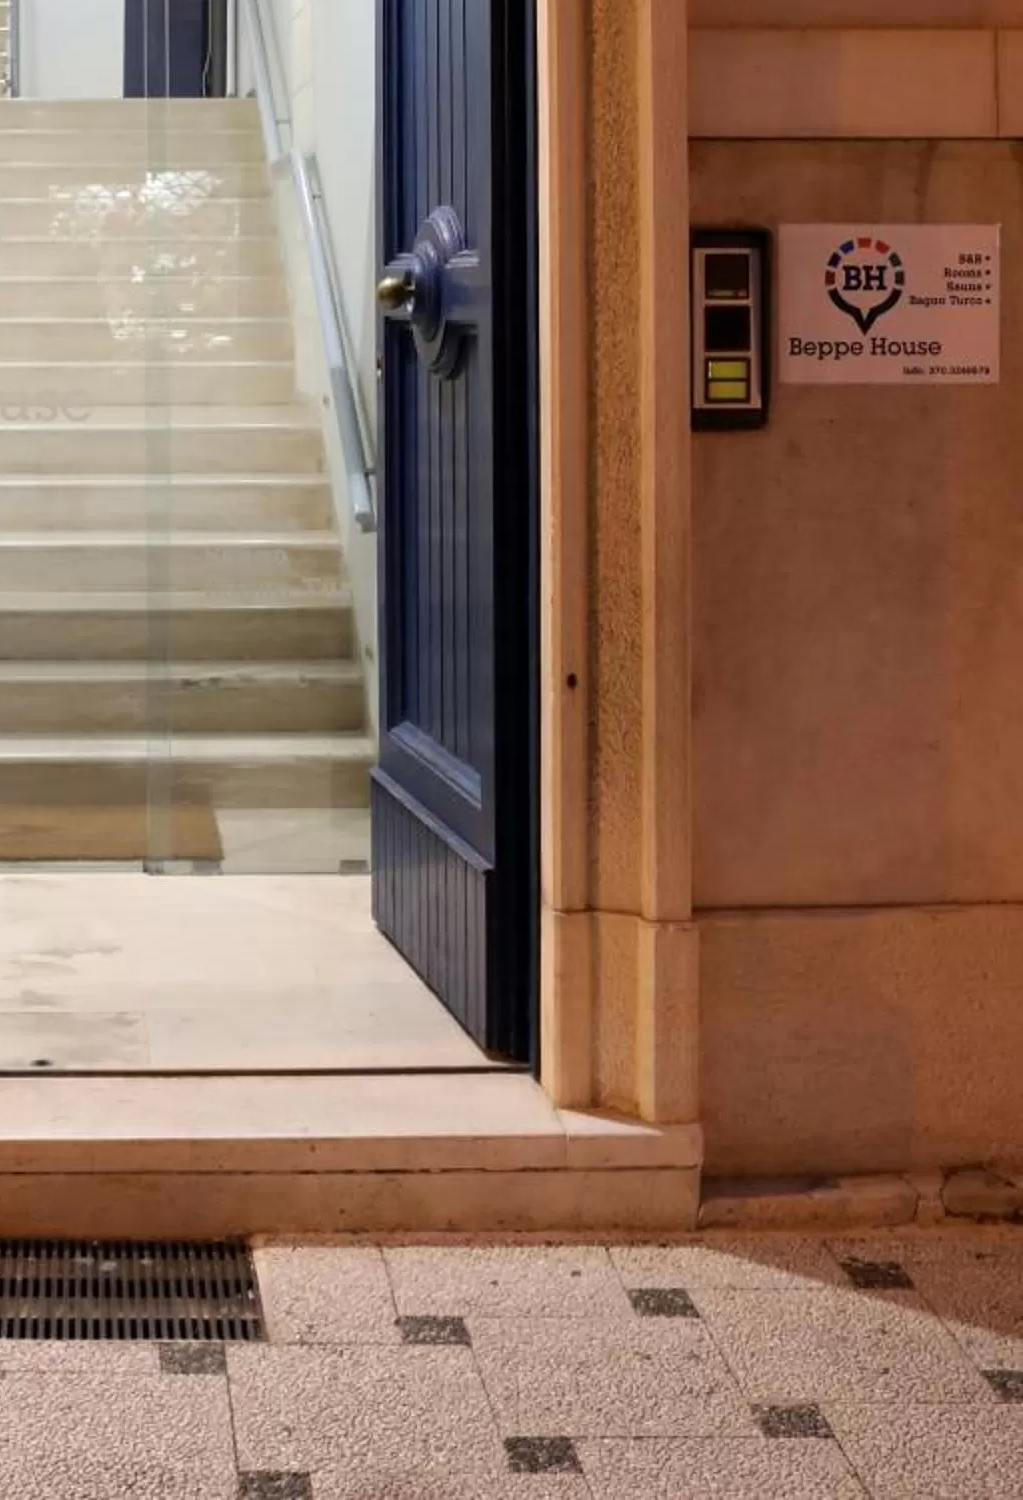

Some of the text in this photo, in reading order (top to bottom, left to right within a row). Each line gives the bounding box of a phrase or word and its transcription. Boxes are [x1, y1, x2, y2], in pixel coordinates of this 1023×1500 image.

[841, 265, 888, 291] BH
[943, 267, 982, 279] Rooms
[946, 281, 982, 293] Sauna
[948, 295, 982, 306] Turco
[788, 337, 942, 361] Beppe House
